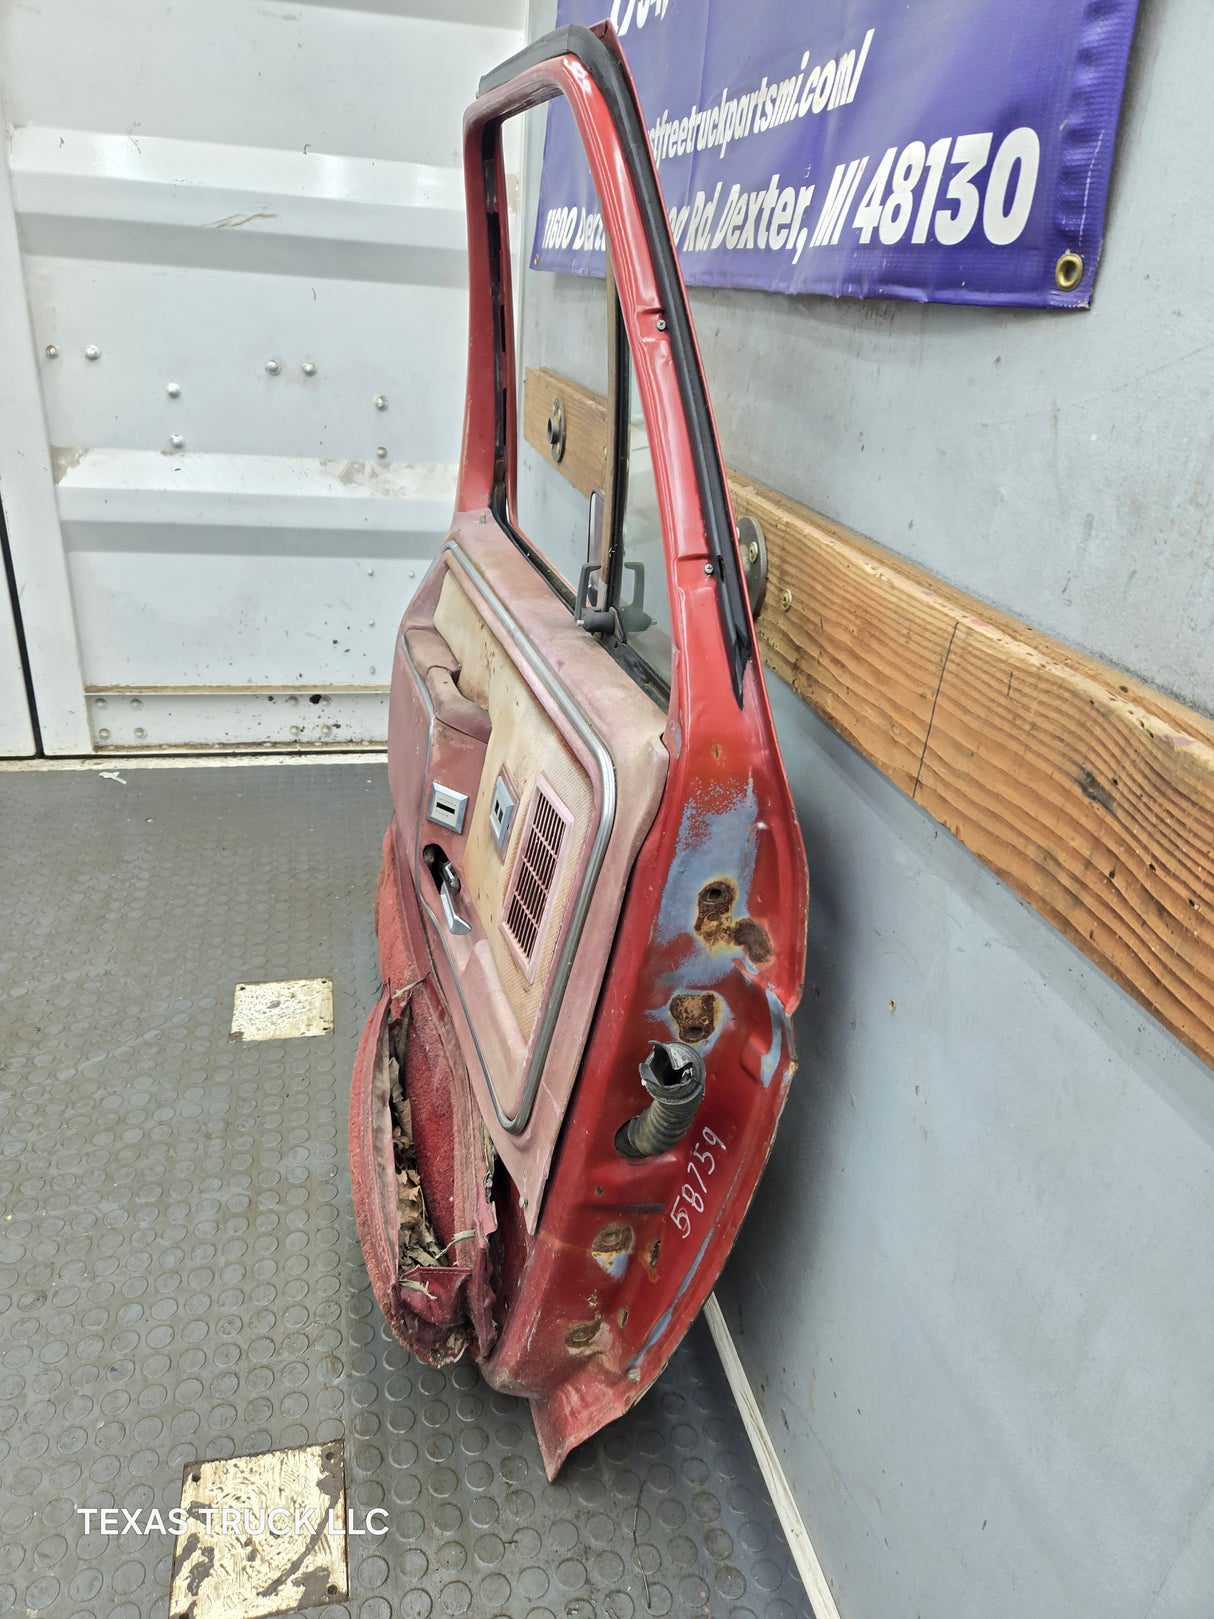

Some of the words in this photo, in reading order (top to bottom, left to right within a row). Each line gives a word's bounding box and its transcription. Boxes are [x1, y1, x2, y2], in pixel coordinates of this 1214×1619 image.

[710, 174, 815, 265] Dexter,
[809, 156, 869, 248] MI
[852, 127, 1040, 245] 48130
